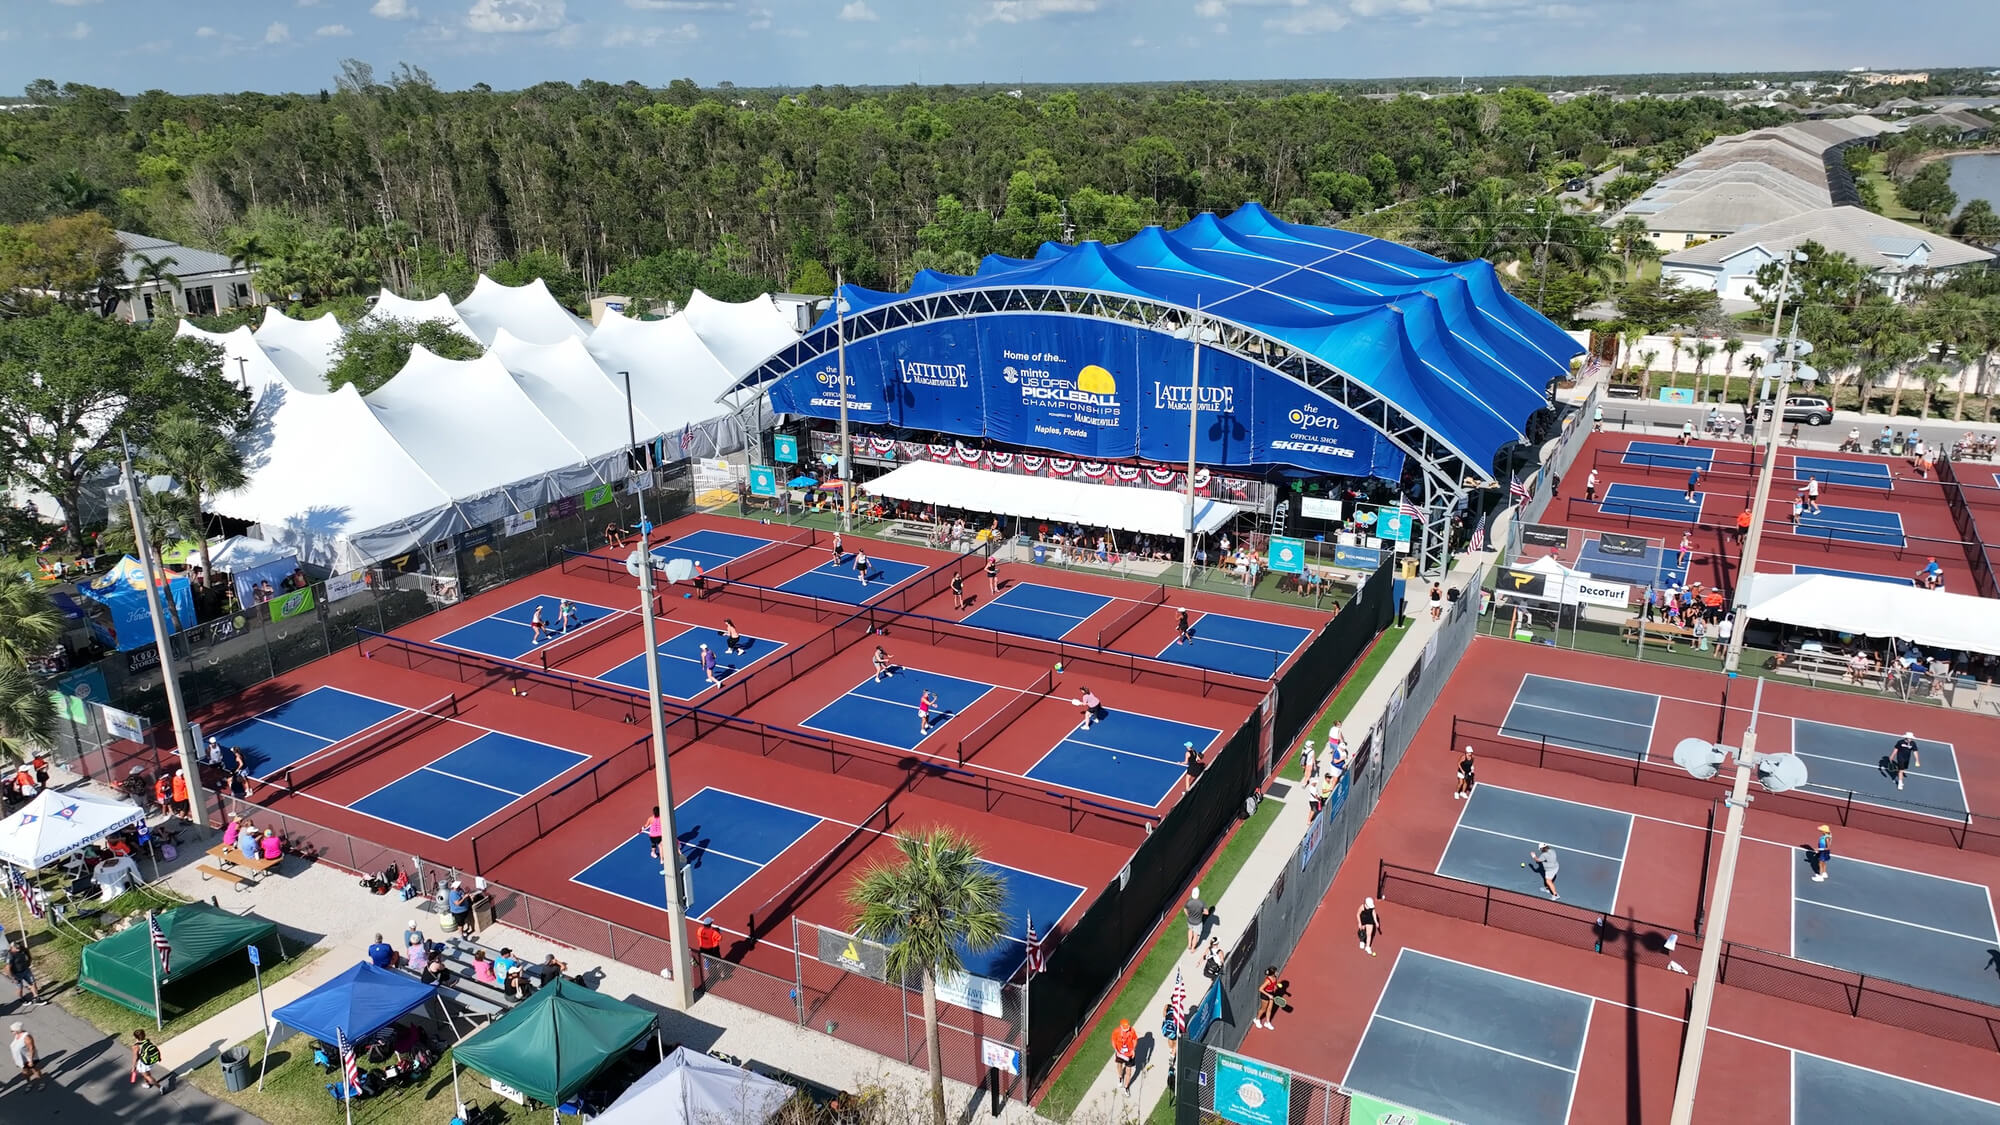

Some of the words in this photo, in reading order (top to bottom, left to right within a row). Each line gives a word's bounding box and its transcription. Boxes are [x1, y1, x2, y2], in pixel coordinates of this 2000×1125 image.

[1003, 350, 1029, 361] Home
[1031, 353, 1042, 362] of
[1044, 353, 1067, 363] the...
[825, 366, 838, 374] the
[898, 359, 968, 388] LATITUDE
[1020, 368, 1050, 379] minto
[1021, 377, 1039, 388] US
[1041, 379, 1077, 390] OPEN
[1021, 387, 1121, 407] PICKLEBALL
[810, 398, 872, 411] SKECERS
[1022, 398, 1121, 416] CHAMPIONSHIPS
[1303, 403, 1318, 413] the
[1288, 409, 1339, 430] Open
[1034, 425, 1062, 436] Naples,
[1063, 428, 1088, 438] Florida
[1290, 432, 1319, 443] OFFICIAL
[1320, 436, 1338, 445] SHOE
[1270, 440, 1355, 458] SKECHERS
[1579, 585, 1625, 599] DecoTurf
[42, 841, 80, 863] OCEAN
[81, 829, 108, 845] REEF
[110, 814, 137, 831] CLUB
[836, 955, 866, 970] JOOLA
